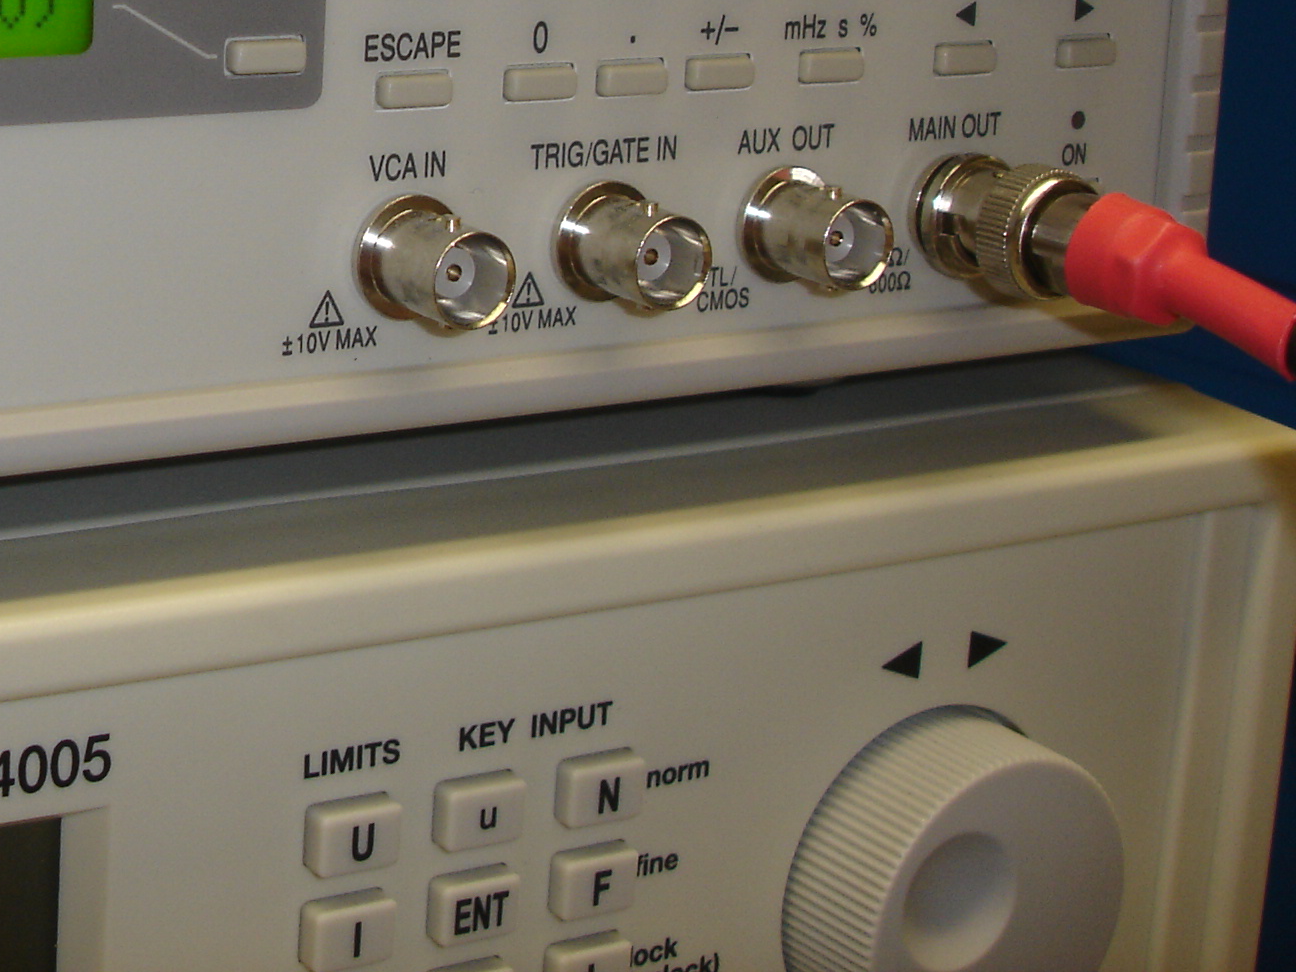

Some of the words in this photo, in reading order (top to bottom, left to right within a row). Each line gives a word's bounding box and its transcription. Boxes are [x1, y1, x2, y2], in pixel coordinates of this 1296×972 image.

[533, 21, 549, 53] 0
[784, 13, 826, 40] mHz
[838, 18, 848, 38] s
[860, 12, 877, 37] %
[364, 30, 461, 62] ESCAPE
[738, 128, 780, 155] AUX
[792, 123, 835, 151] OUT
[908, 116, 956, 142] MAIN
[961, 111, 1001, 137] OUT
[369, 153, 417, 182] VCA
[424, 150, 446, 178] IN
[531, 136, 649, 170] TRIG/GATE
[657, 135, 677, 161] IN
[1062, 142, 1087, 166] ON
[697, 286, 750, 313] CMOS
[537, 305, 577, 329] MAX
[335, 326, 378, 349] MAX
[458, 719, 516, 752] KEY
[530, 701, 614, 739] INPUT
[303, 739, 402, 779] LIMITS
[646, 760, 711, 789] norm
[597, 776, 622, 815] N
[351, 823, 375, 862] U
[592, 869, 613, 907] F
[454, 890, 510, 936] ENT
